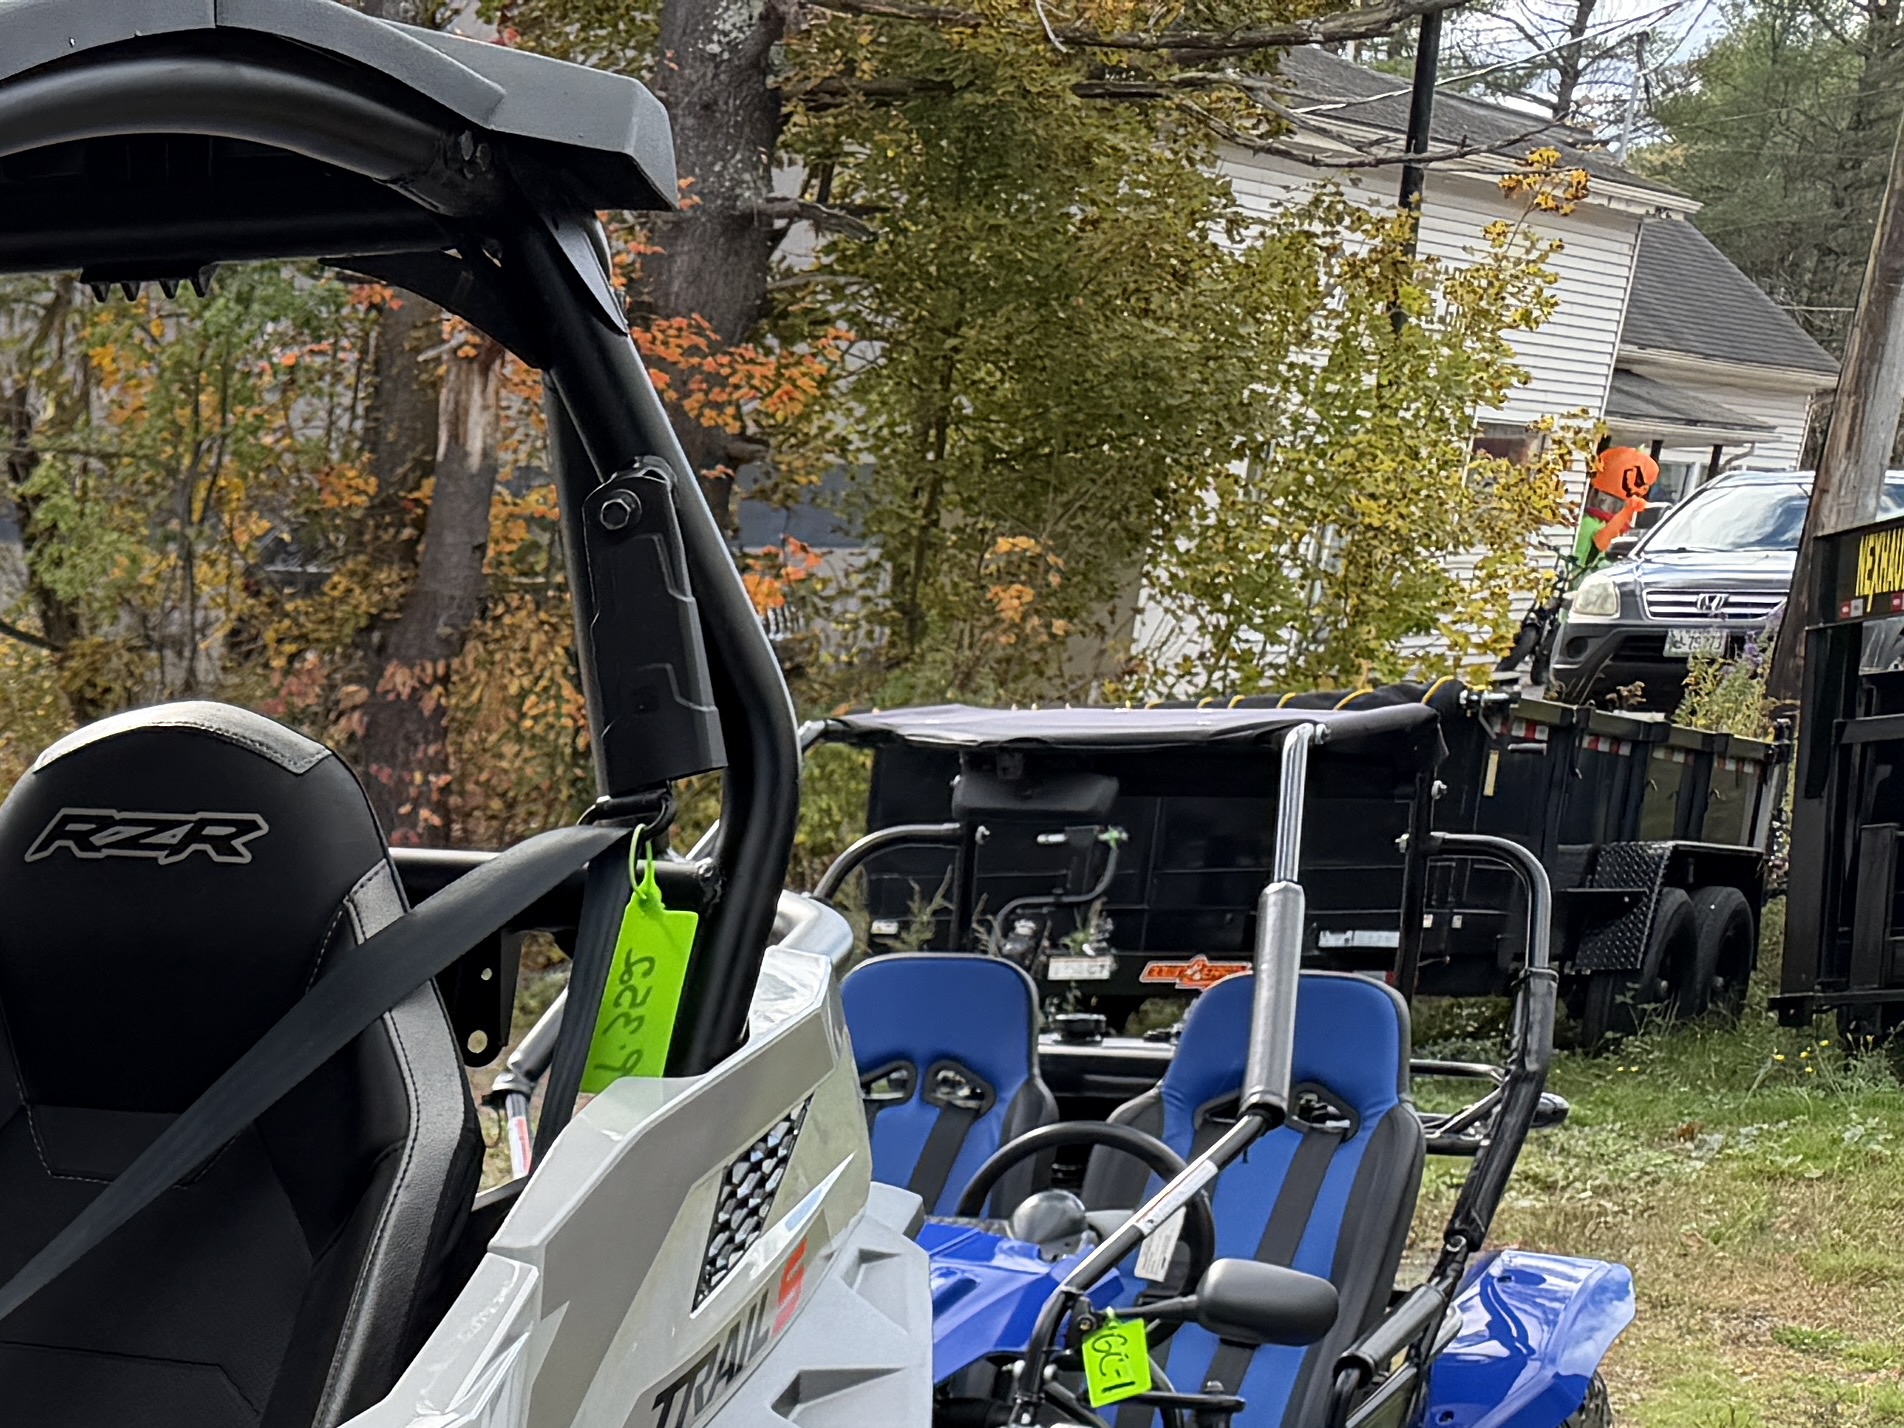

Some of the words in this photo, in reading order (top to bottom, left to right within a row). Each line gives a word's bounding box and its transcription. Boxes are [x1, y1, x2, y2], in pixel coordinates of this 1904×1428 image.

[1855, 527, 1904, 612] NEXHAU
[24, 807, 269, 865] RZR
[771, 1237, 808, 1338] S
